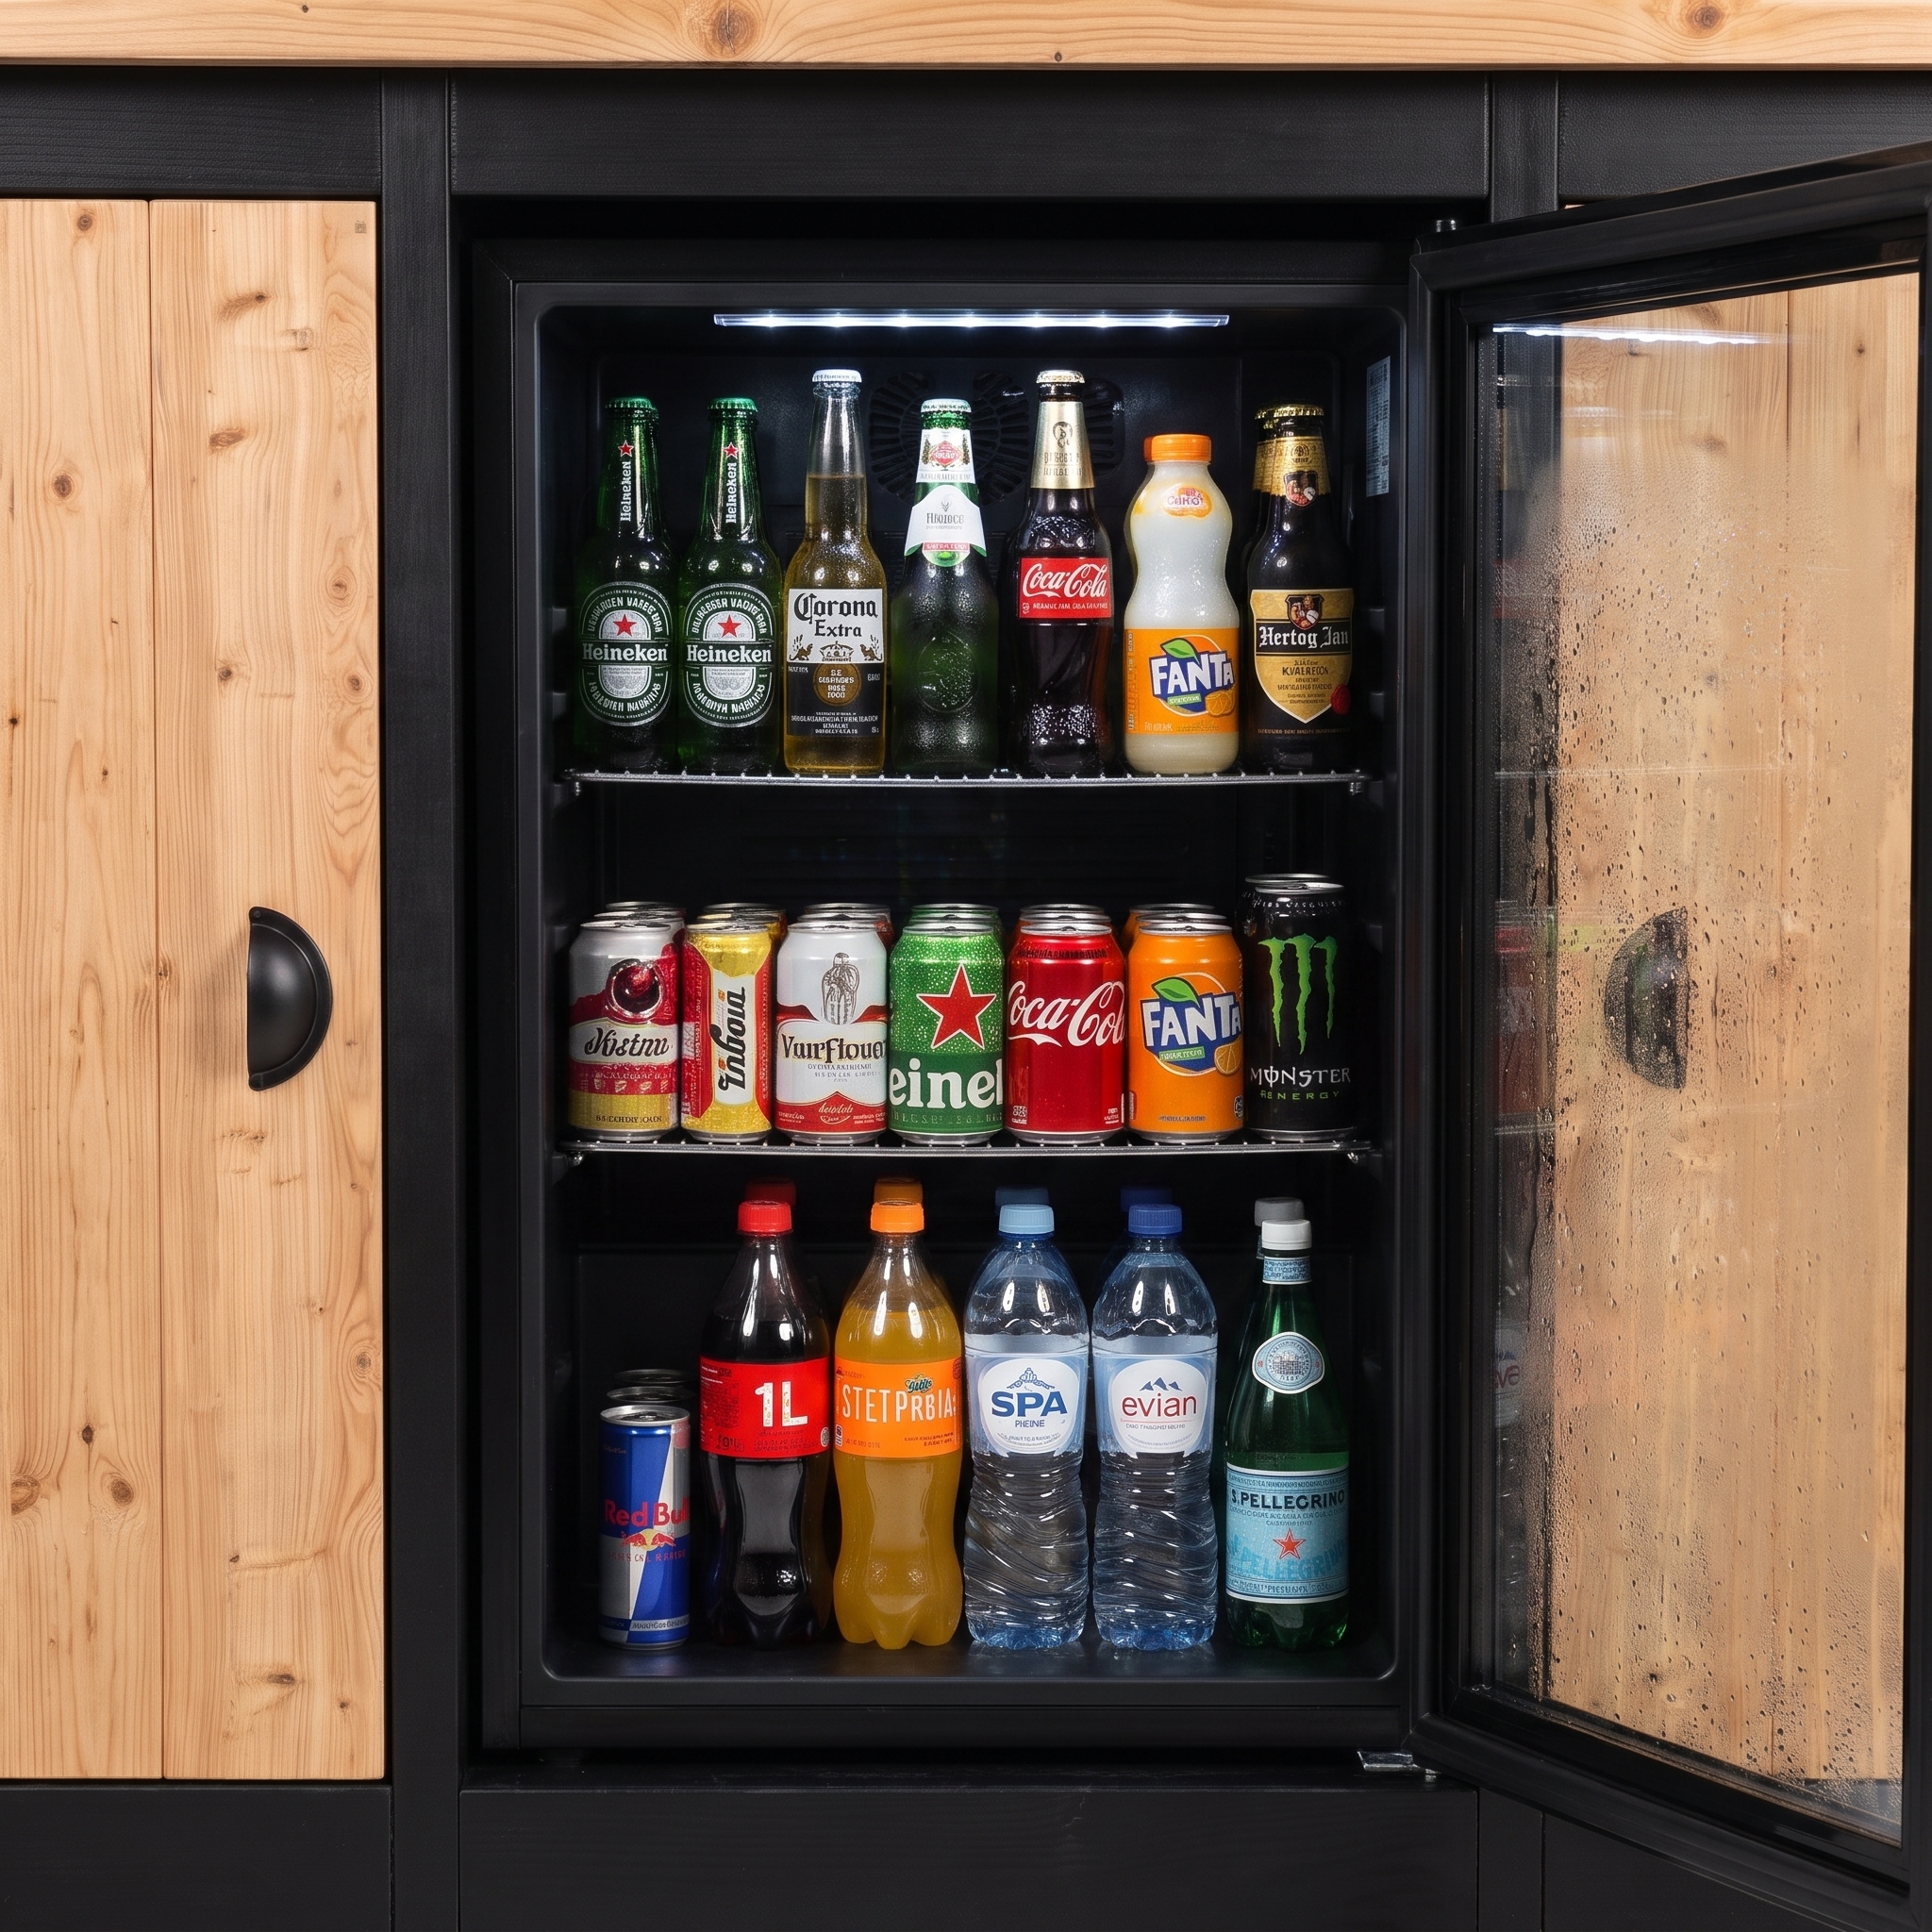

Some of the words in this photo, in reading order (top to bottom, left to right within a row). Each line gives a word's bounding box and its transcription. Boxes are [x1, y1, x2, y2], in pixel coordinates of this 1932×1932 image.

[1023, 563, 1108, 598] Coca-Cola
[793, 592, 878, 625] Corona
[814, 619, 862, 638] Extra
[1258, 625, 1318, 649] Hertog
[1320, 625, 1349, 649] Jan
[582, 642, 668, 661] Heineken
[687, 644, 773, 662] Heineken
[1151, 653, 1235, 695] FANTA
[1142, 995, 1242, 1047] FANTA
[754, 1381, 808, 1427] 1L
[991, 1391, 1068, 1418] SPA
[1122, 1392, 1197, 1417] evian
[605, 1499, 649, 1527] Red
